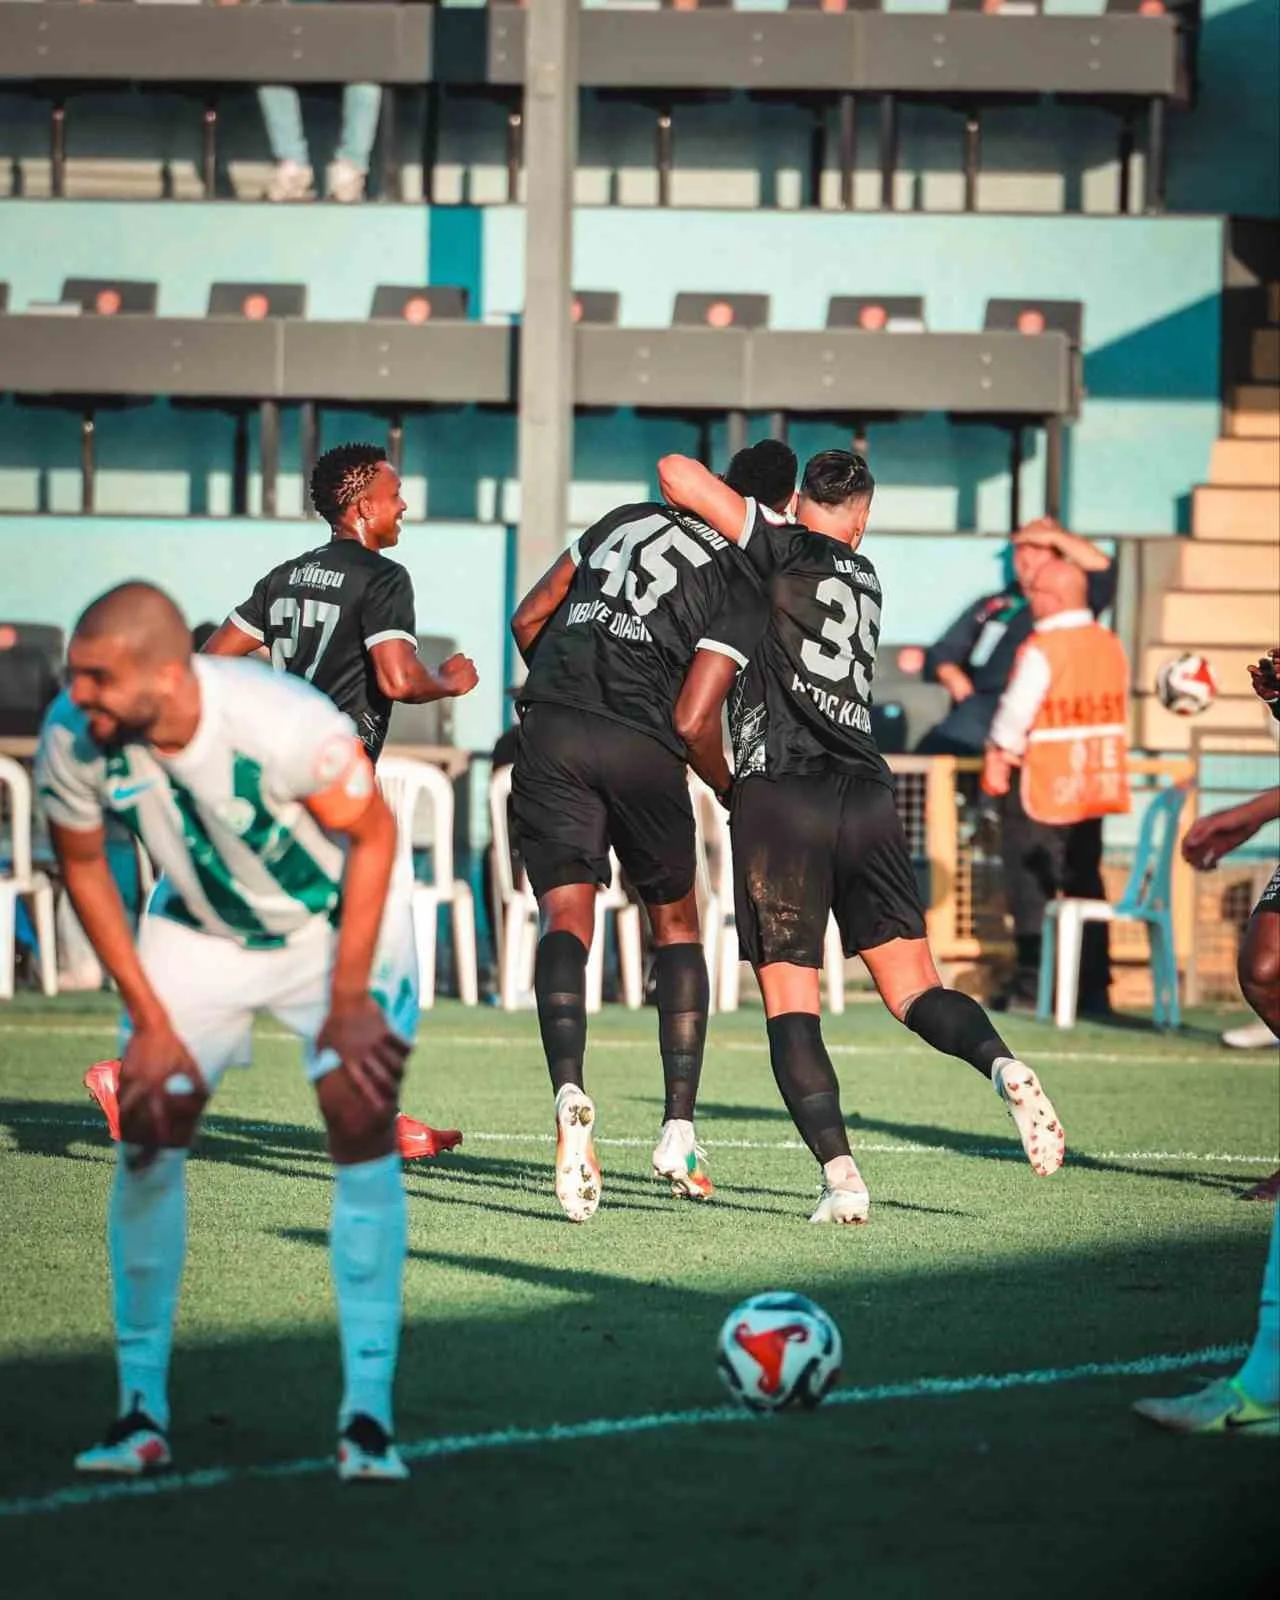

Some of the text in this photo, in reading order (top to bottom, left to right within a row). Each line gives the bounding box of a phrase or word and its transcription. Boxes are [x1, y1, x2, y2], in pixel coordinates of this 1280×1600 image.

[588, 513, 713, 617] 45
[269, 597, 341, 682] 27
[800, 576, 882, 703] 35
